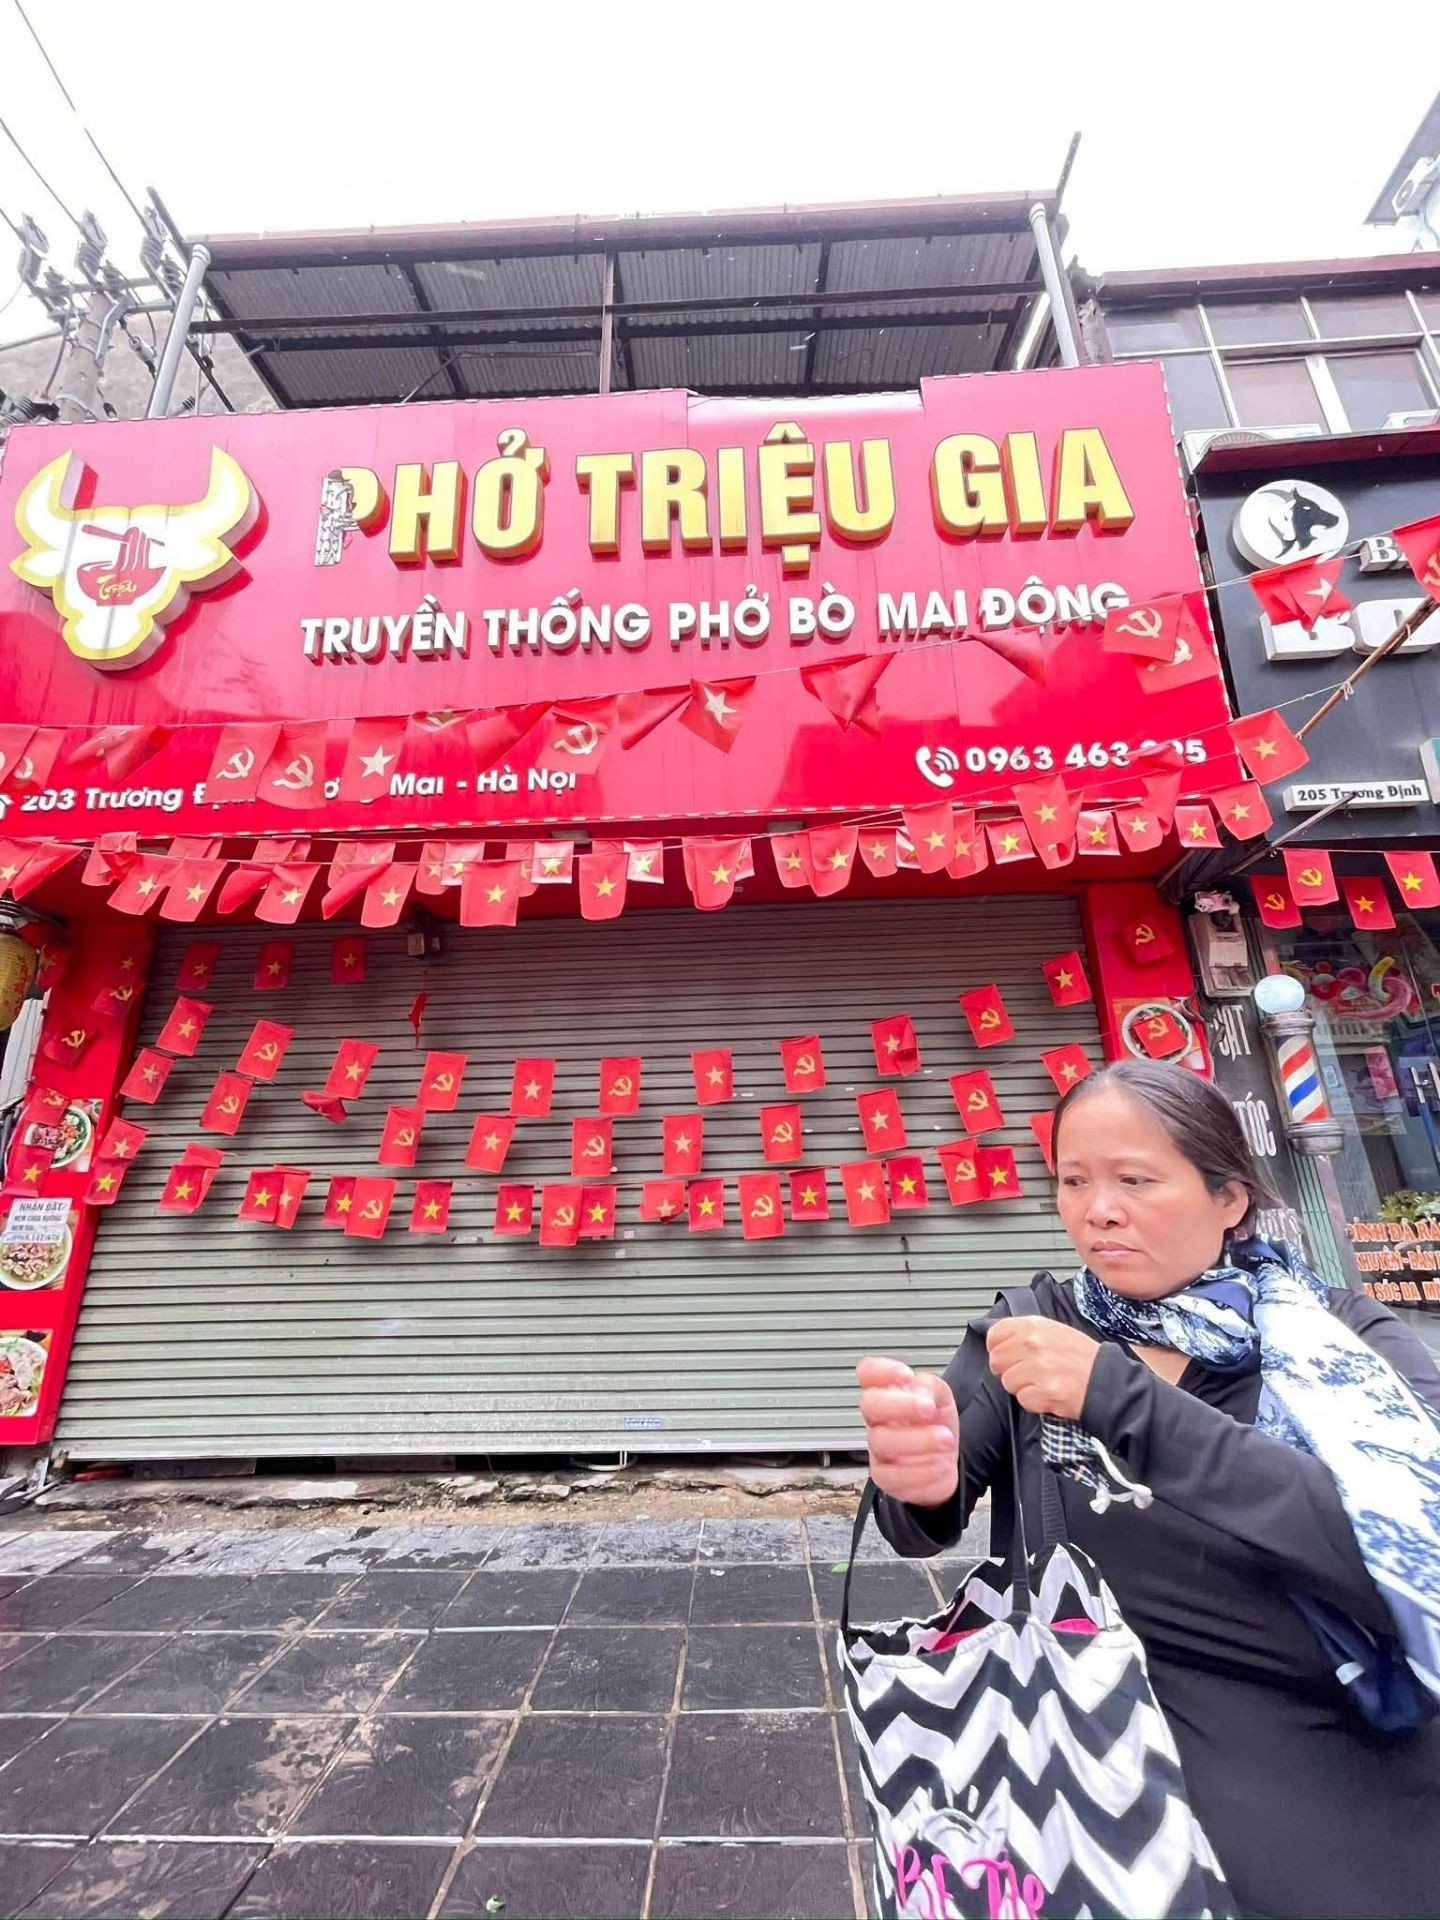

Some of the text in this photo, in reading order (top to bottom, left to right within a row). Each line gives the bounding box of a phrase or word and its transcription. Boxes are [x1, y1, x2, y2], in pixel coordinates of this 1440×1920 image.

[314, 421, 1135, 572] PHỞ TRIỆU GIA
[301, 593, 466, 660] TRUYỀN
[483, 588, 651, 653] THỐNG
[668, 583, 771, 646] PHỞ
[788, 581, 856, 640] BÒ
[877, 589, 968, 637] MAI
[965, 746, 1054, 772] 0963
[1065, 742, 1130, 768] 463
[389, 771, 444, 797] Mai
[477, 765, 518, 793] Hà
[528, 767, 576, 795] Nội
[1297, 789, 1327, 802] 205
[20, 788, 77, 812] 203
[85, 787, 183, 812] Trương
